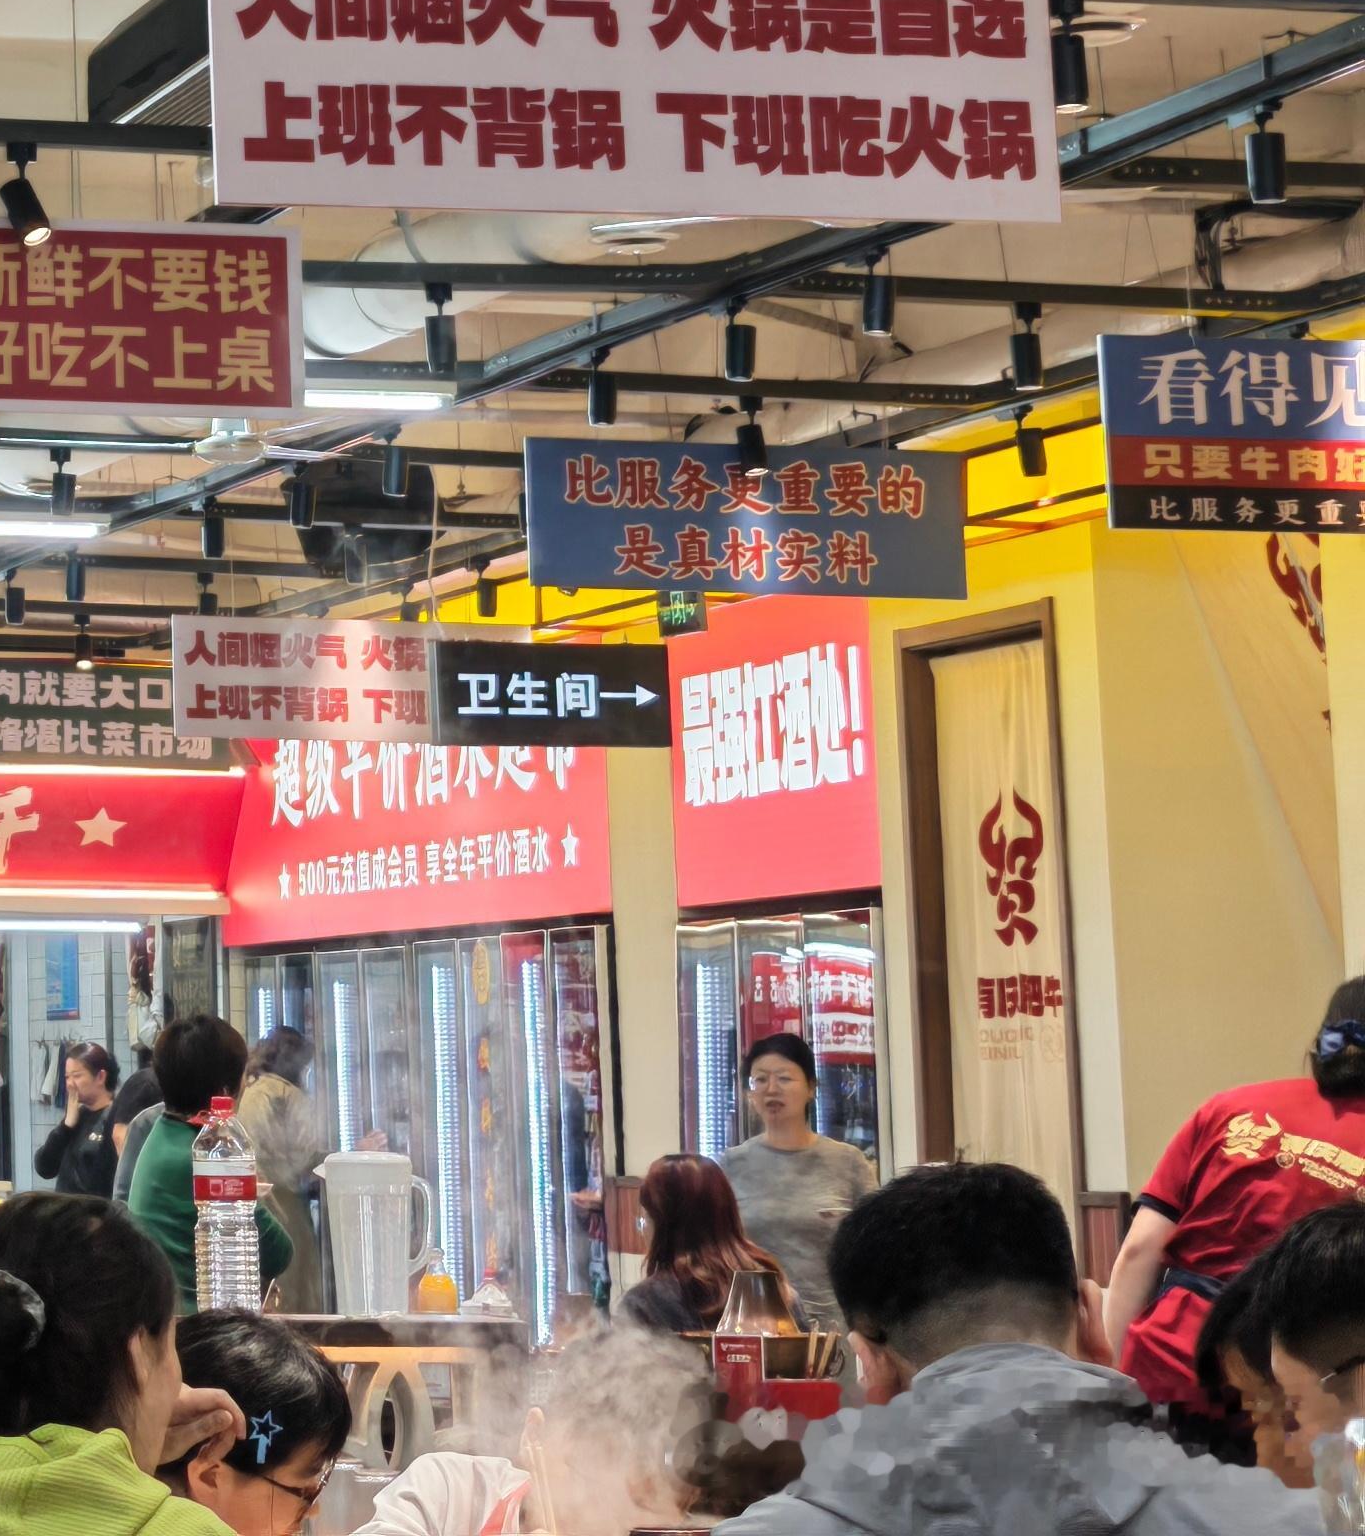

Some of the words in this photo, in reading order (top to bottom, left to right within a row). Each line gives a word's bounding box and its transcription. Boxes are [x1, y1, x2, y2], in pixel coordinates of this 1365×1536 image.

[243, 81, 624, 172] 上班不背锅
[656, 93, 1038, 182] 下班吃火锅
[1138, 349, 1365, 428] 看得见
[566, 454, 924, 520] 比服务更重要的
[614, 525, 877, 584] 是真材实料
[184, 631, 347, 670] 人间烟火气
[186, 684, 348, 722] 上班不背锅
[457, 671, 596, 718] 卫生间
[298, 845, 419, 896] 500元充值成会员
[425, 827, 550, 885] 享全年平价酒水
